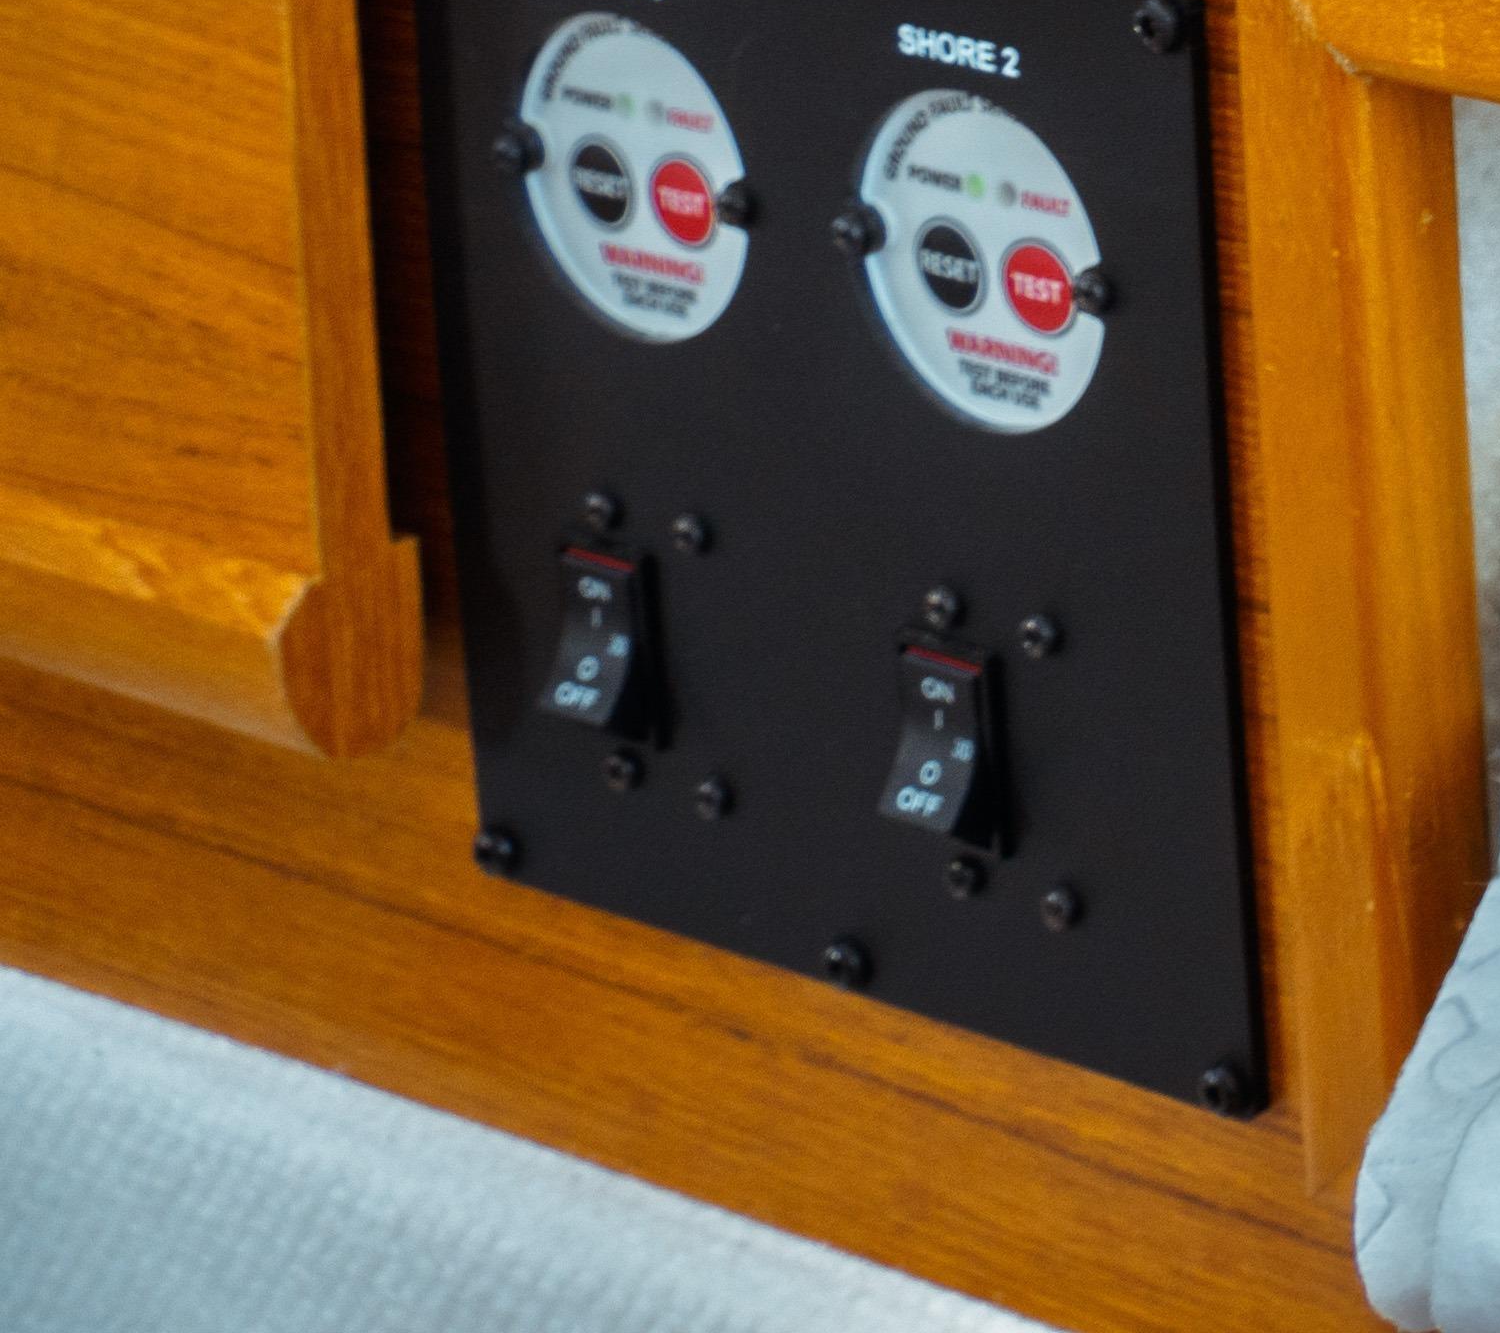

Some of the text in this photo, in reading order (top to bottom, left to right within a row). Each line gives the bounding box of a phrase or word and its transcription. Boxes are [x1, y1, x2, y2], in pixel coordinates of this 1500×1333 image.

[897, 23, 1022, 79] SHORE 2
[572, 164, 629, 197] RESET
[908, 165, 963, 192] POWER
[656, 183, 708, 217] TEST
[1021, 190, 1072, 218] FAULT
[919, 247, 979, 284] RESET
[1010, 271, 1063, 304] TEST
[553, 680, 600, 711] OFF
[895, 784, 946, 818] OFF
